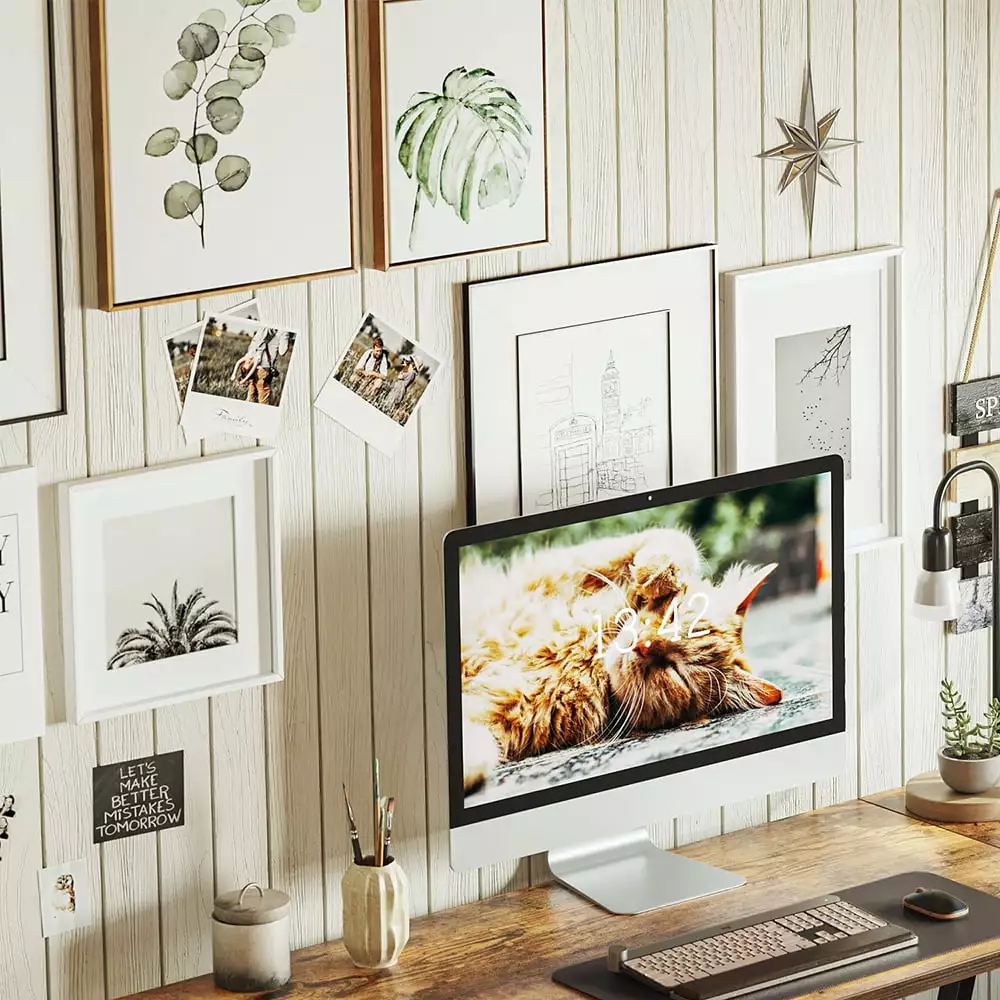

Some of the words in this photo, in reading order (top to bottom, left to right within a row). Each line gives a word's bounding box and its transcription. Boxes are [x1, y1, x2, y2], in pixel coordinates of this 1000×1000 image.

[592, 592, 712, 660] 13:42
[120, 761, 156, 779] LET'S
[119, 773, 158, 793] MAKE
[111, 785, 169, 808] BETTER
[95, 808, 182, 837] TOMORROW
